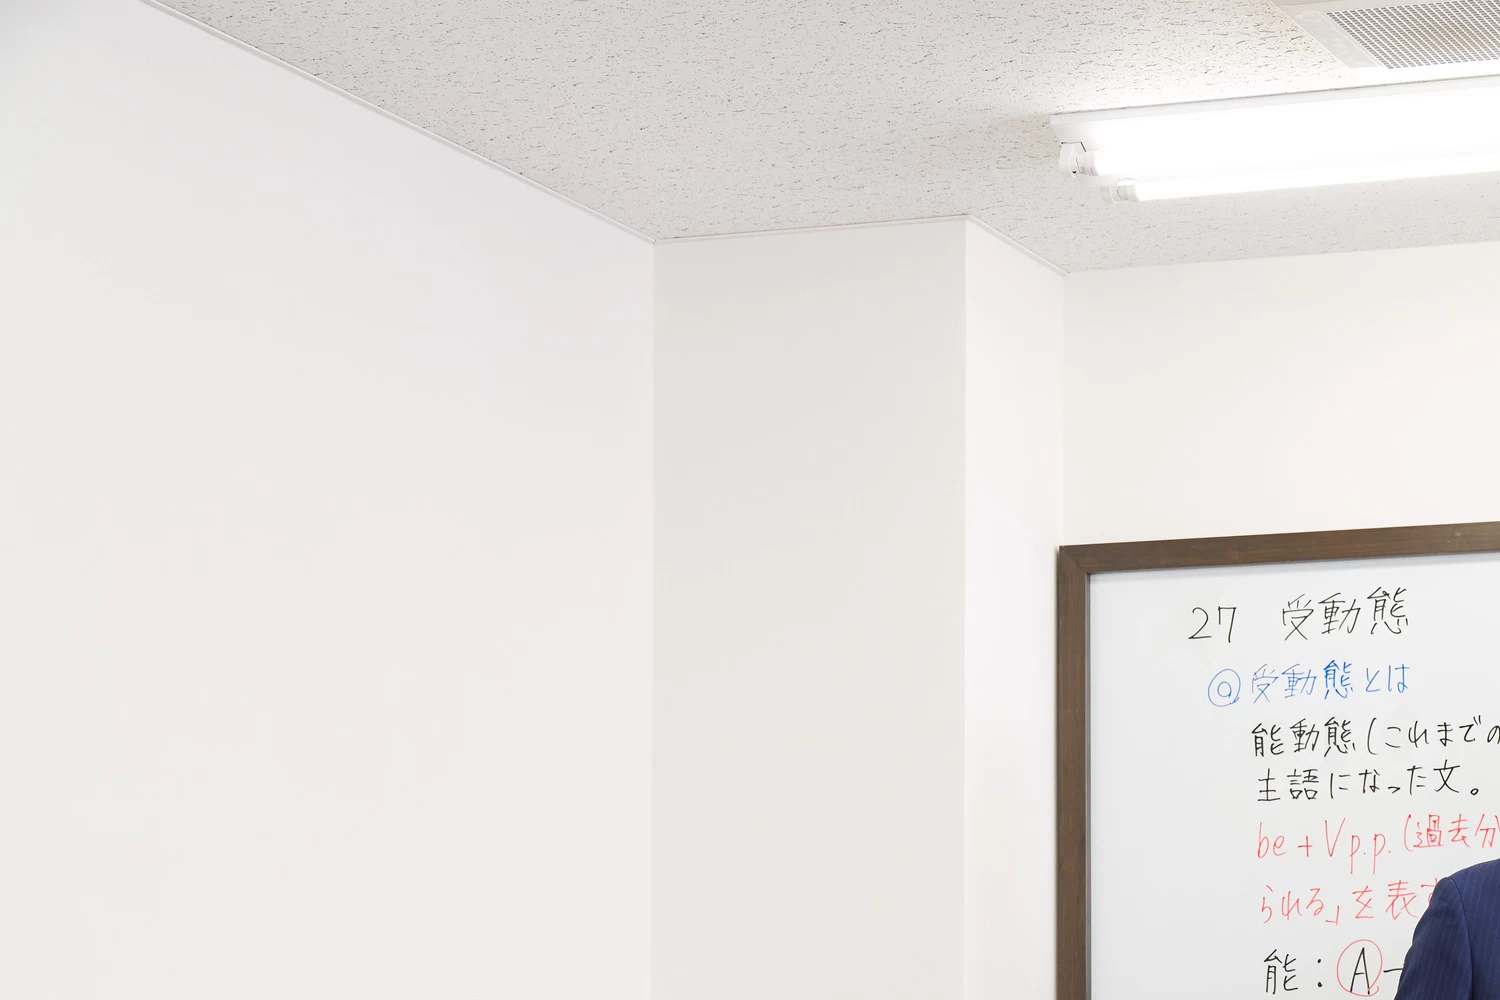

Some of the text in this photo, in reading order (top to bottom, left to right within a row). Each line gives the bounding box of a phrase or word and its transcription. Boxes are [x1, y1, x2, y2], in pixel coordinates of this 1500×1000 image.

[1188, 587, 1409, 644] 27 受動態
[1257, 759, 1480, 802] 主語になった文。
[1257, 822, 1287, 859] be
